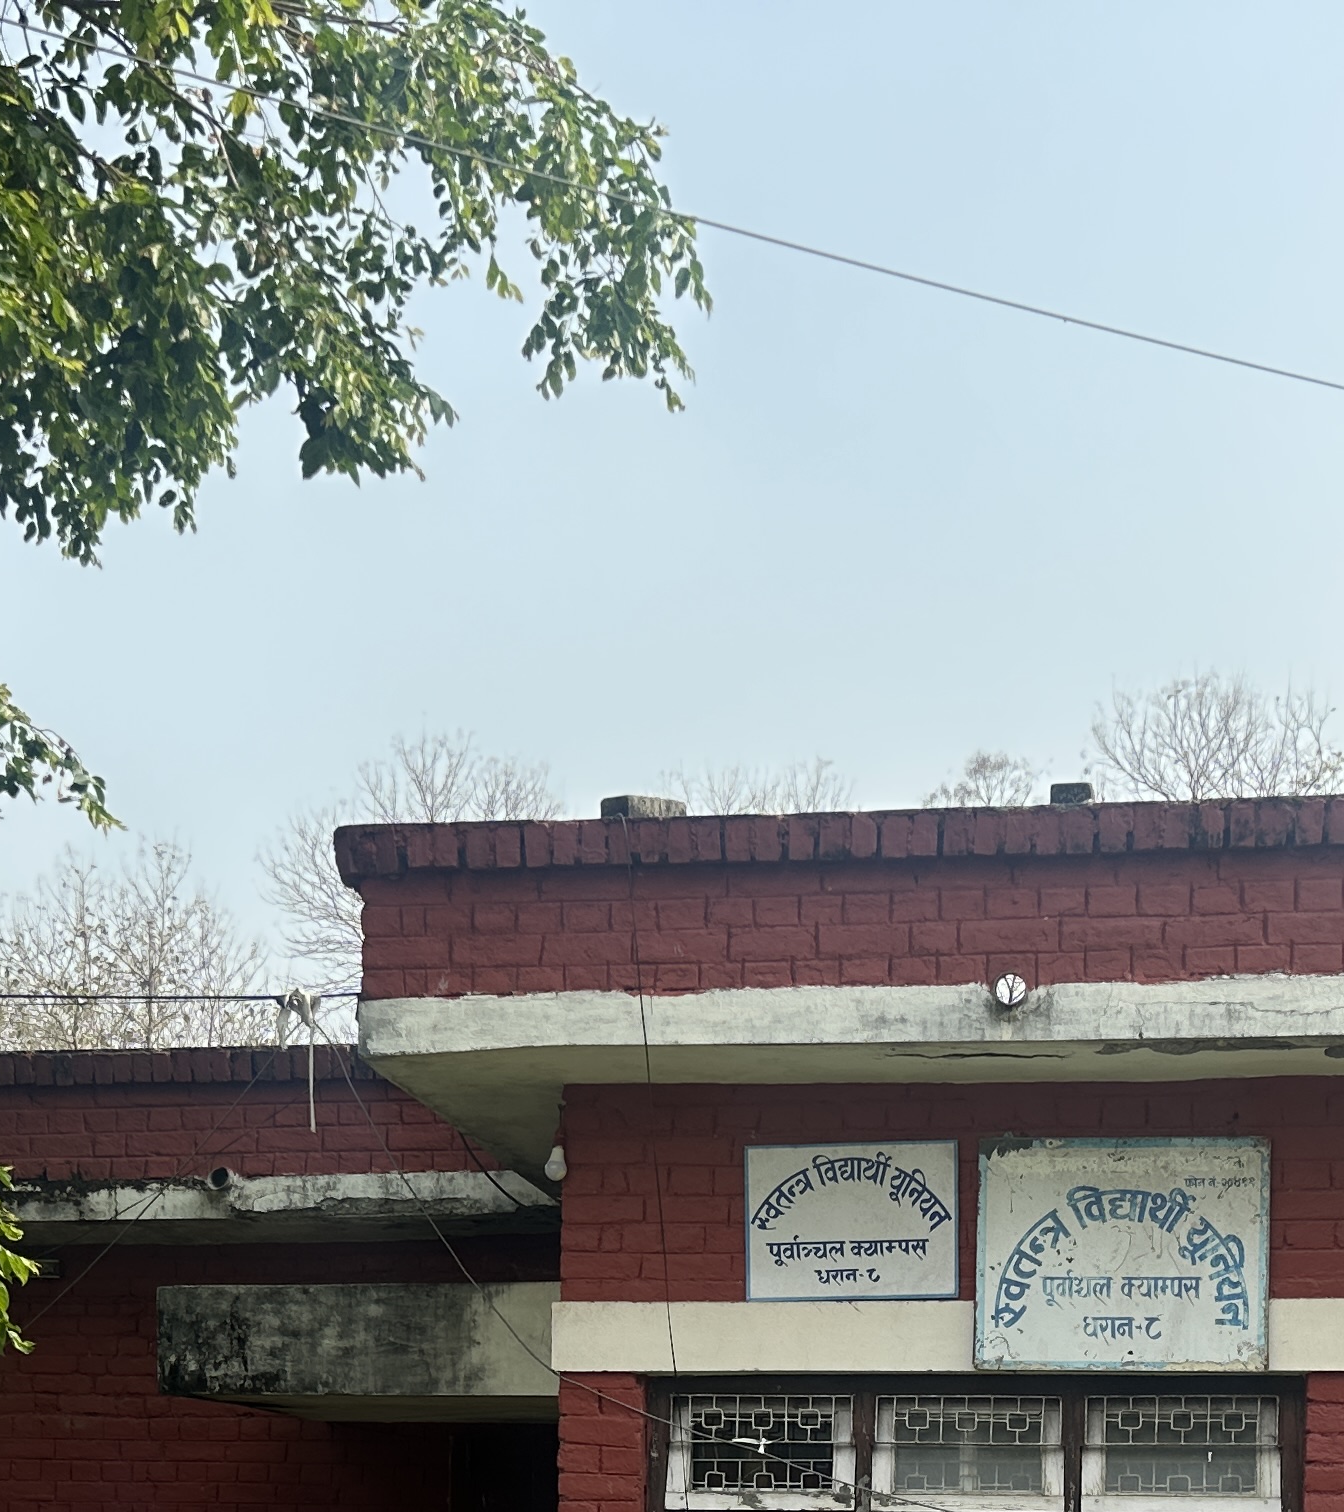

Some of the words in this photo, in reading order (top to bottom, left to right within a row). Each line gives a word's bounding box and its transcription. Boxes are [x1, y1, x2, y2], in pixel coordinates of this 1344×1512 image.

[751, 1167, 814, 1230] स्वतन्त्र
[812, 1151, 892, 1187] विद्यार्थी
[890, 1166, 952, 1232] यूनियन
[849, 1239, 929, 1260] क्याम्पस
[994, 1208, 1071, 1328] स्वतन्त्र
[1066, 1185, 1196, 1233] विद्यार्थी
[1179, 1216, 1249, 1330] यूनियन
[1121, 1276, 1202, 1306] क्याम्पस
